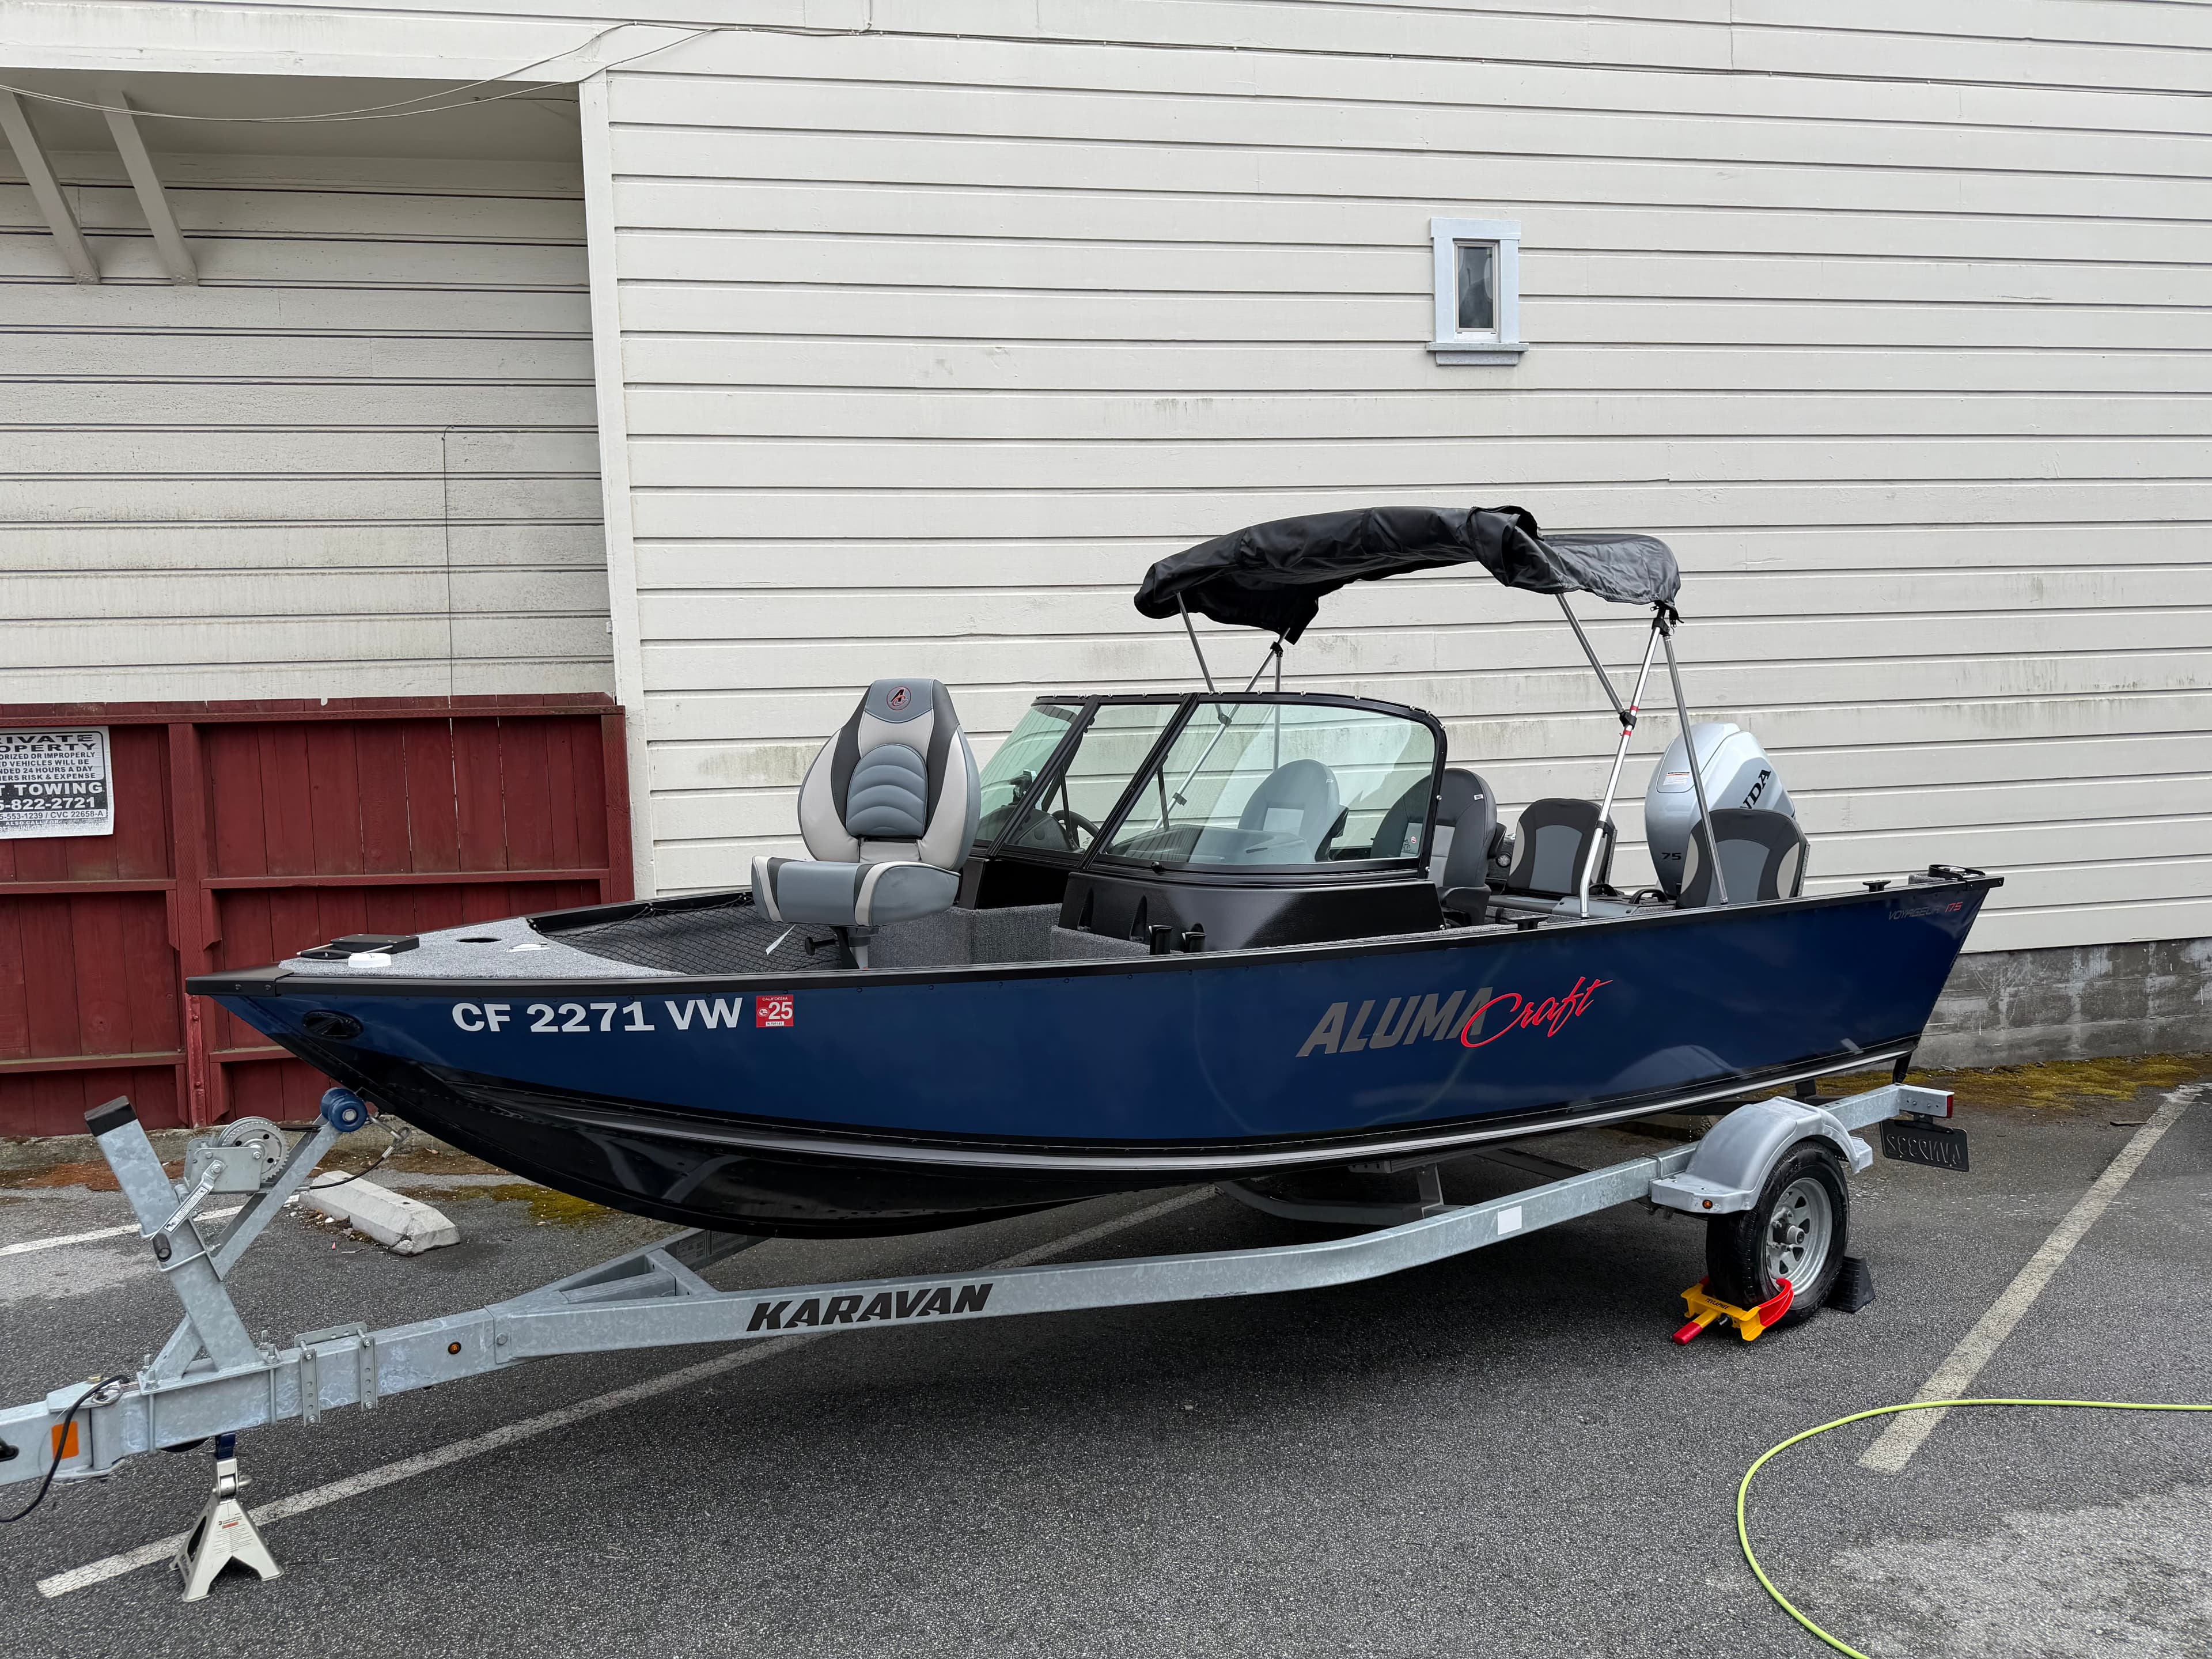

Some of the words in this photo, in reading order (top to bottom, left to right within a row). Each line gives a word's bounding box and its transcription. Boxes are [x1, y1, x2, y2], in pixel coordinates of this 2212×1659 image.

[0, 734, 93, 744] IVATE
[14, 782, 103, 796] TOWING
[1740, 769, 1771, 809] NDA
[1945, 902, 1963, 912] 175
[452, 1003, 511, 1032] CF
[527, 1001, 654, 1032] 2271
[665, 998, 743, 1030] VW
[768, 1002, 793, 1020] 25
[746, 1283, 994, 1331] KARAVAN
